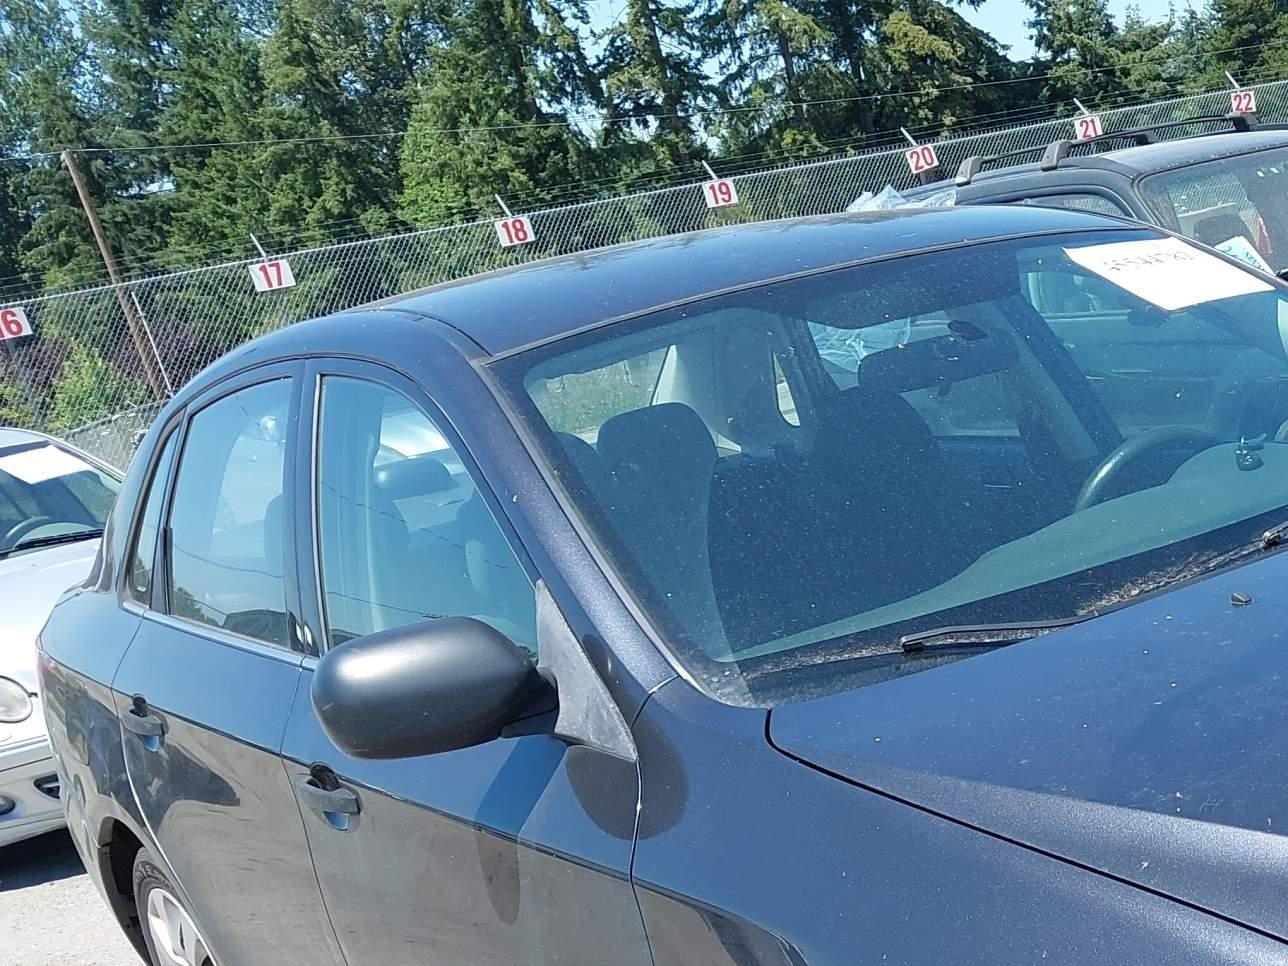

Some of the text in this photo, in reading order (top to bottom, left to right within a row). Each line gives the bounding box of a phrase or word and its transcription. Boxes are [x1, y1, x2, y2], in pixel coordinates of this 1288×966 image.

[1233, 93, 1253, 112] 22
[1079, 118, 1098, 138] 21
[910, 147, 933, 171] 20
[708, 181, 732, 206] 19
[502, 219, 528, 243] 18
[258, 263, 284, 288] 17
[0, 310, 23, 338] 6
